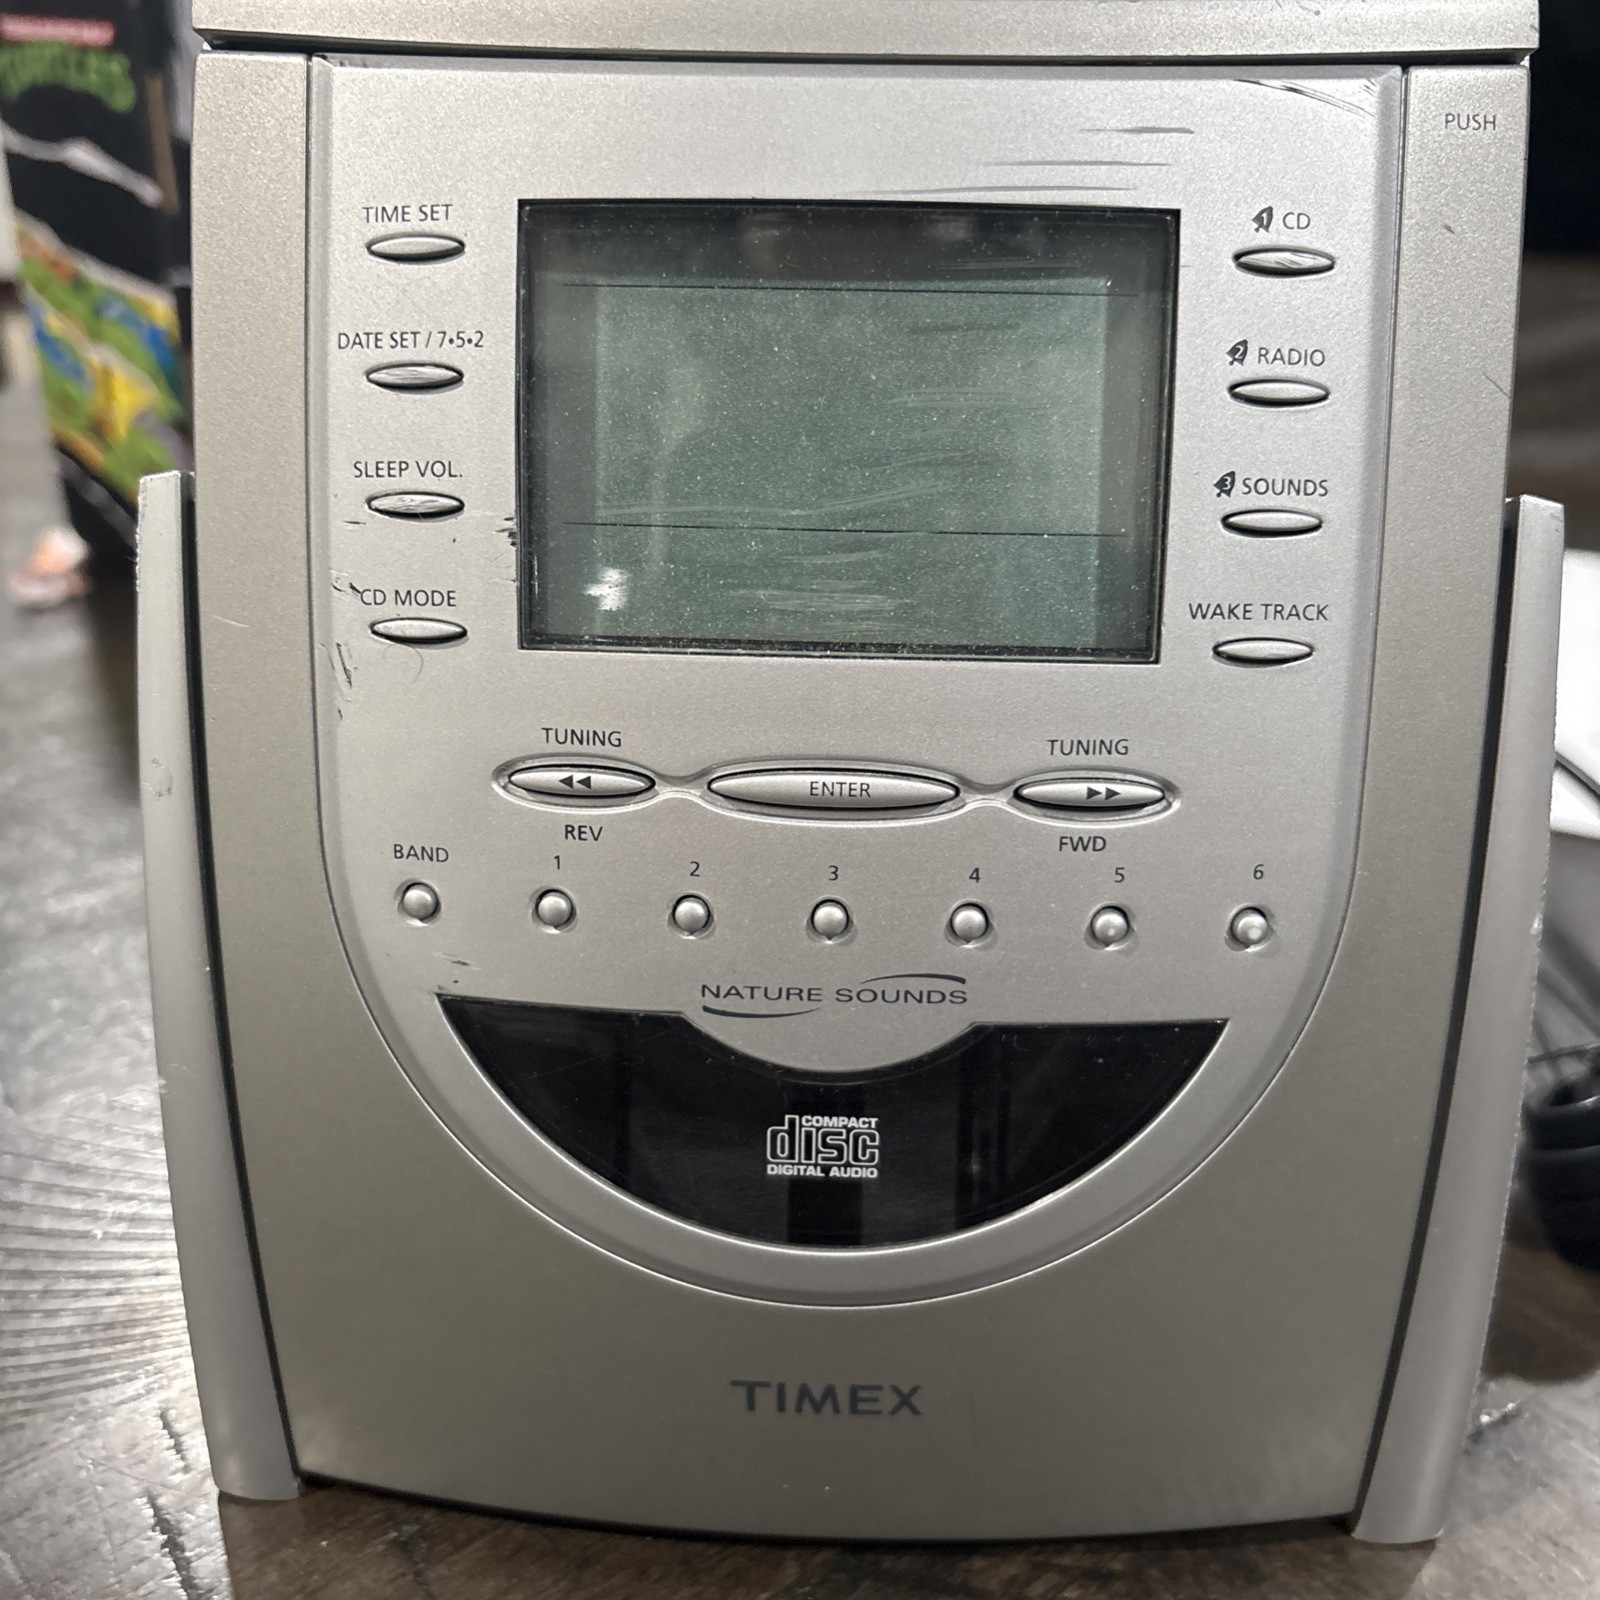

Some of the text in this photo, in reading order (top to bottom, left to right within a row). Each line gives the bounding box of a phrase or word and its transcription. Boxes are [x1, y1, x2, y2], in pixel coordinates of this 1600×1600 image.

[1444, 112, 1497, 132] PUSH
[362, 204, 453, 223] TIME SET
[1282, 211, 1311, 230] CD
[337, 332, 384, 350] DATE
[389, 331, 421, 349] SET
[425, 331, 432, 349] /
[1257, 346, 1326, 367] RADIO
[353, 460, 463, 478] SLEEP VOL.
[1241, 477, 1329, 497] SOUNDS
[360, 588, 457, 607] CD MODE
[1188, 602, 1329, 621] WAKE TRACK
[541, 727, 622, 748] TUNING
[1047, 738, 1129, 756] TUNING
[809, 781, 871, 798] ENTER
[564, 824, 604, 842] REV
[393, 843, 450, 863] BAND
[1058, 835, 1107, 853] FWD
[553, 855, 561, 871] 1
[689, 860, 701, 878] 2
[1253, 863, 1265, 881] 6
[828, 864, 839, 882] 3
[968, 867, 981, 884] 4
[1114, 866, 1126, 884] 5
[701, 984, 968, 1005] NATURE SOUNDS
[801, 1115, 879, 1129] COMPACT
[766, 1114, 880, 1166] disc
[766, 1163, 879, 1179] DIGITAL AUDIO
[730, 1379, 922, 1416] TIMEX
